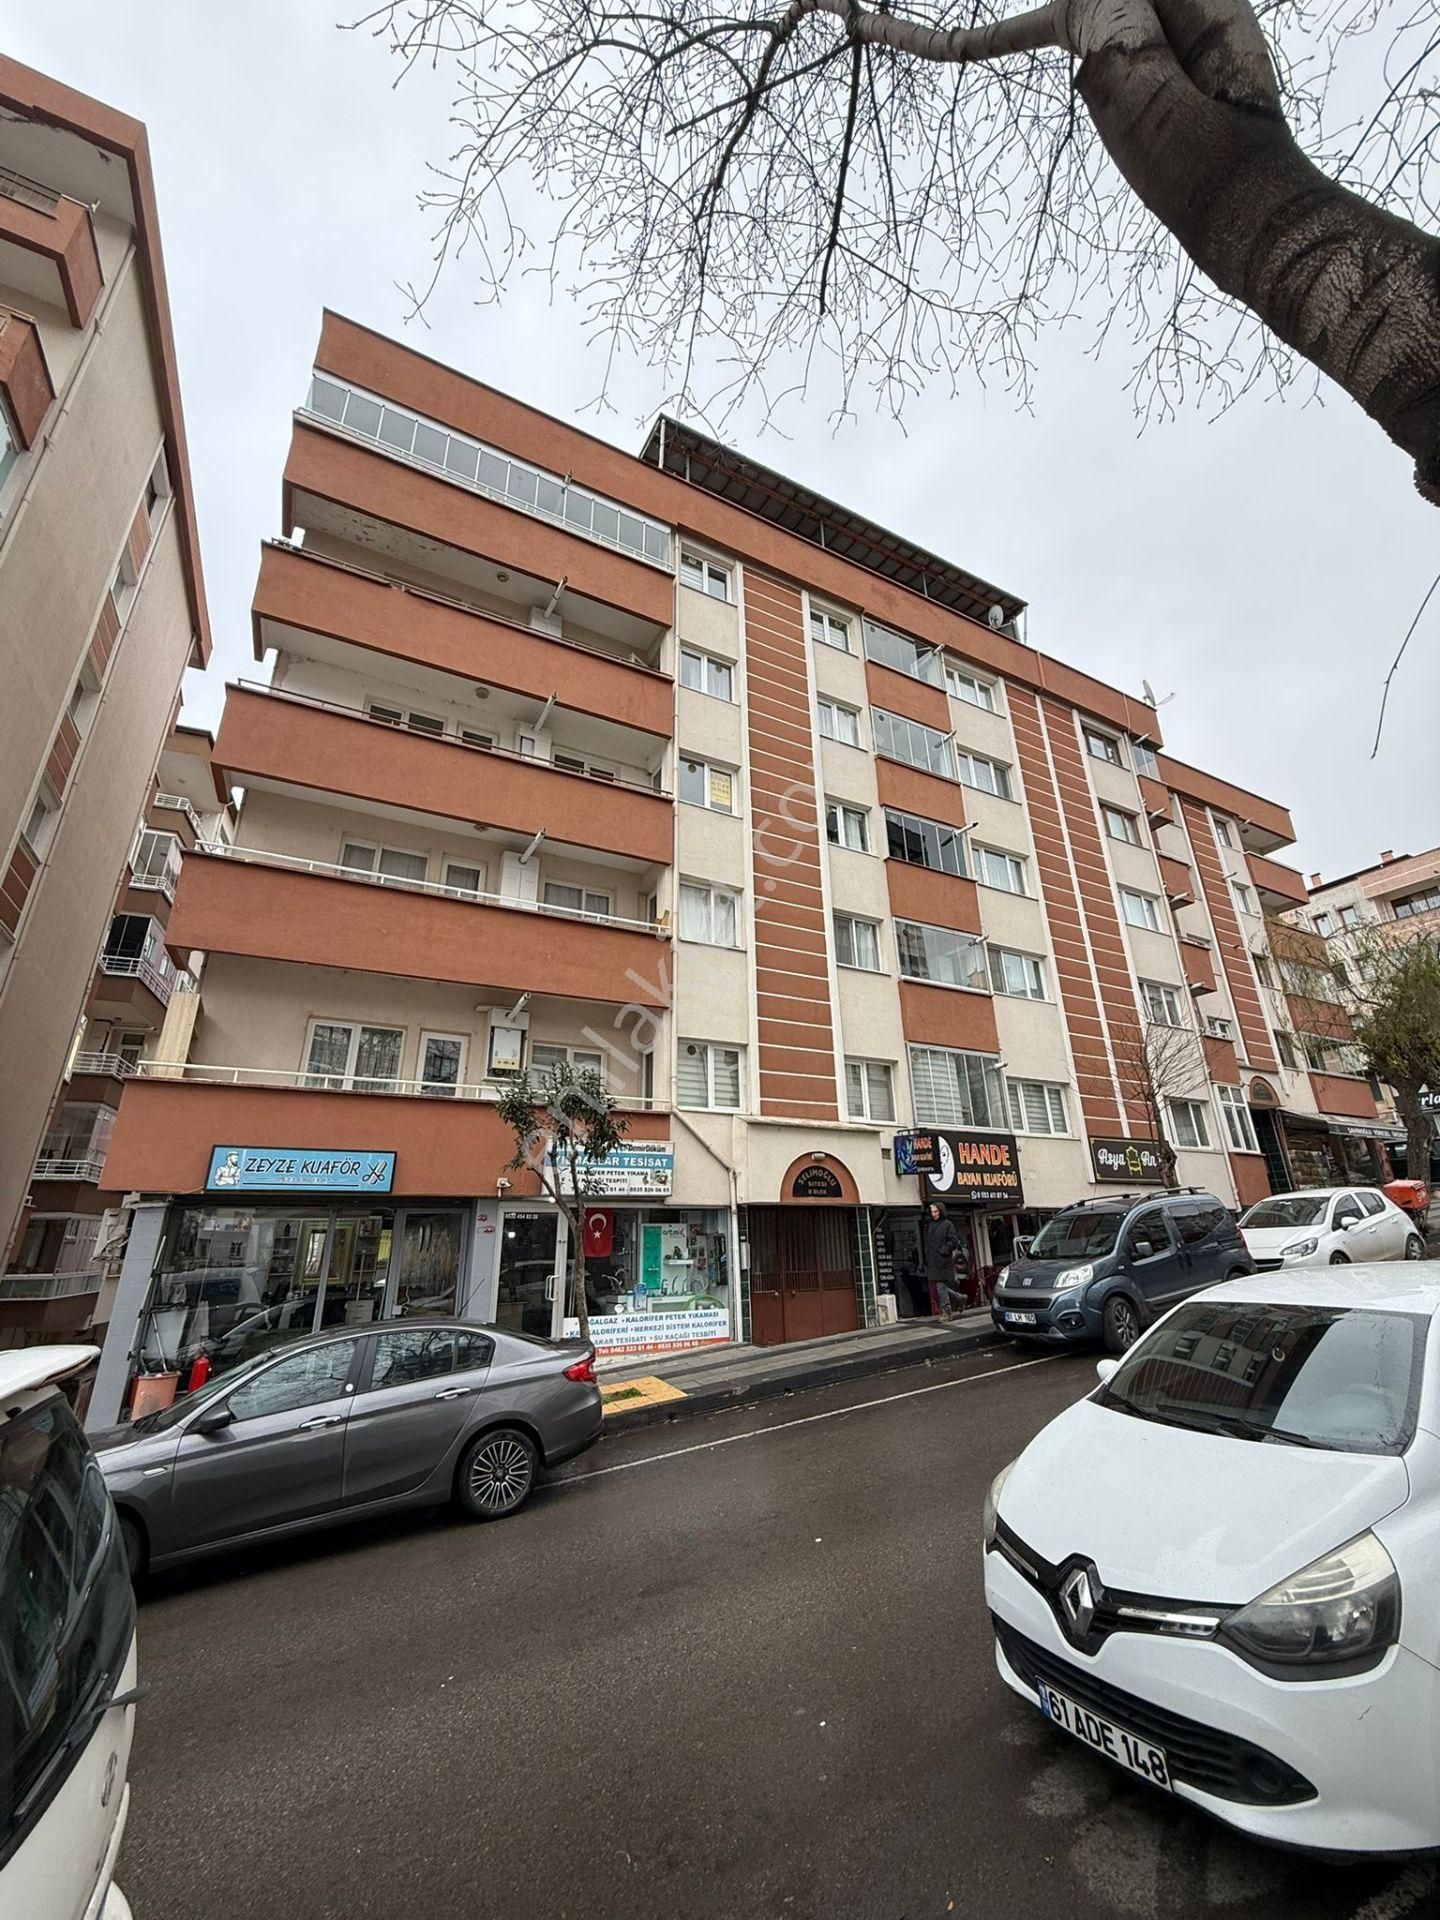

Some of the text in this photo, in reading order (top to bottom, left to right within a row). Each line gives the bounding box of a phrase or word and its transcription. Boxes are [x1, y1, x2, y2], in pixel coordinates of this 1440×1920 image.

[1420, 1093, 1440, 1106] rla
[623, 1156, 669, 1167] TESİSAT
[958, 1142, 1011, 1166] HANDE
[1098, 1148, 1126, 1171] Asya
[245, 1157, 361, 1176] ZEYZE KUAFÖR
[957, 1171, 1018, 1187] BAYAN KUAFÖRÜ
[625, 1313, 664, 1323] KALORİFER
[665, 1312, 686, 1321] PETEK
[588, 1327, 629, 1336] ALORİFERİ
[634, 1324, 665, 1333] MERKEZİ
[666, 1322, 691, 1331] SİSTEM
[1048, 1690, 1168, 1785] 61 ADE 148
